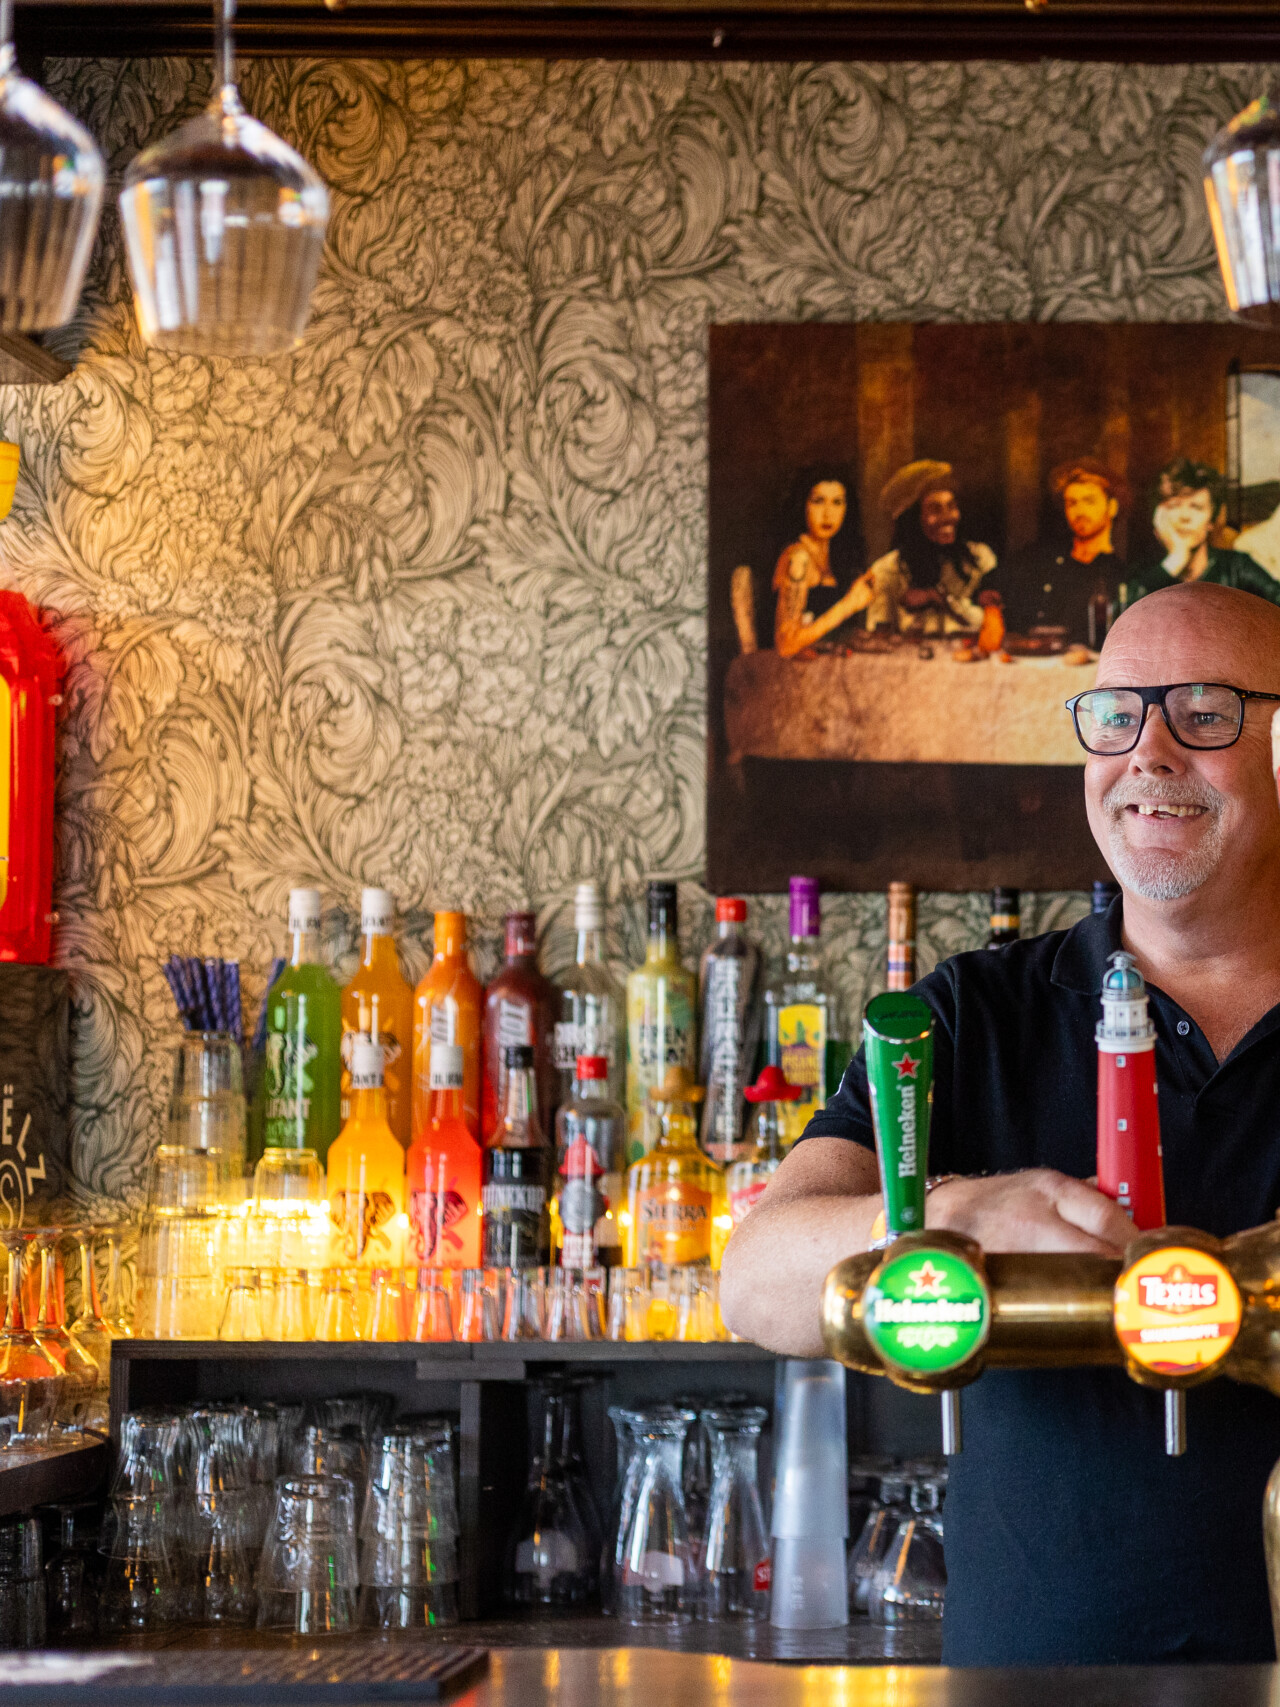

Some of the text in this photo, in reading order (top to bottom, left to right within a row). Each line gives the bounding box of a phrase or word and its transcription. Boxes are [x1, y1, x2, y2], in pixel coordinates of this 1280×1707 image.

[898, 1084, 917, 1178] Heineken
[1140, 1277, 1217, 1306] TEXELS
[874, 1298, 981, 1323] Heineken
